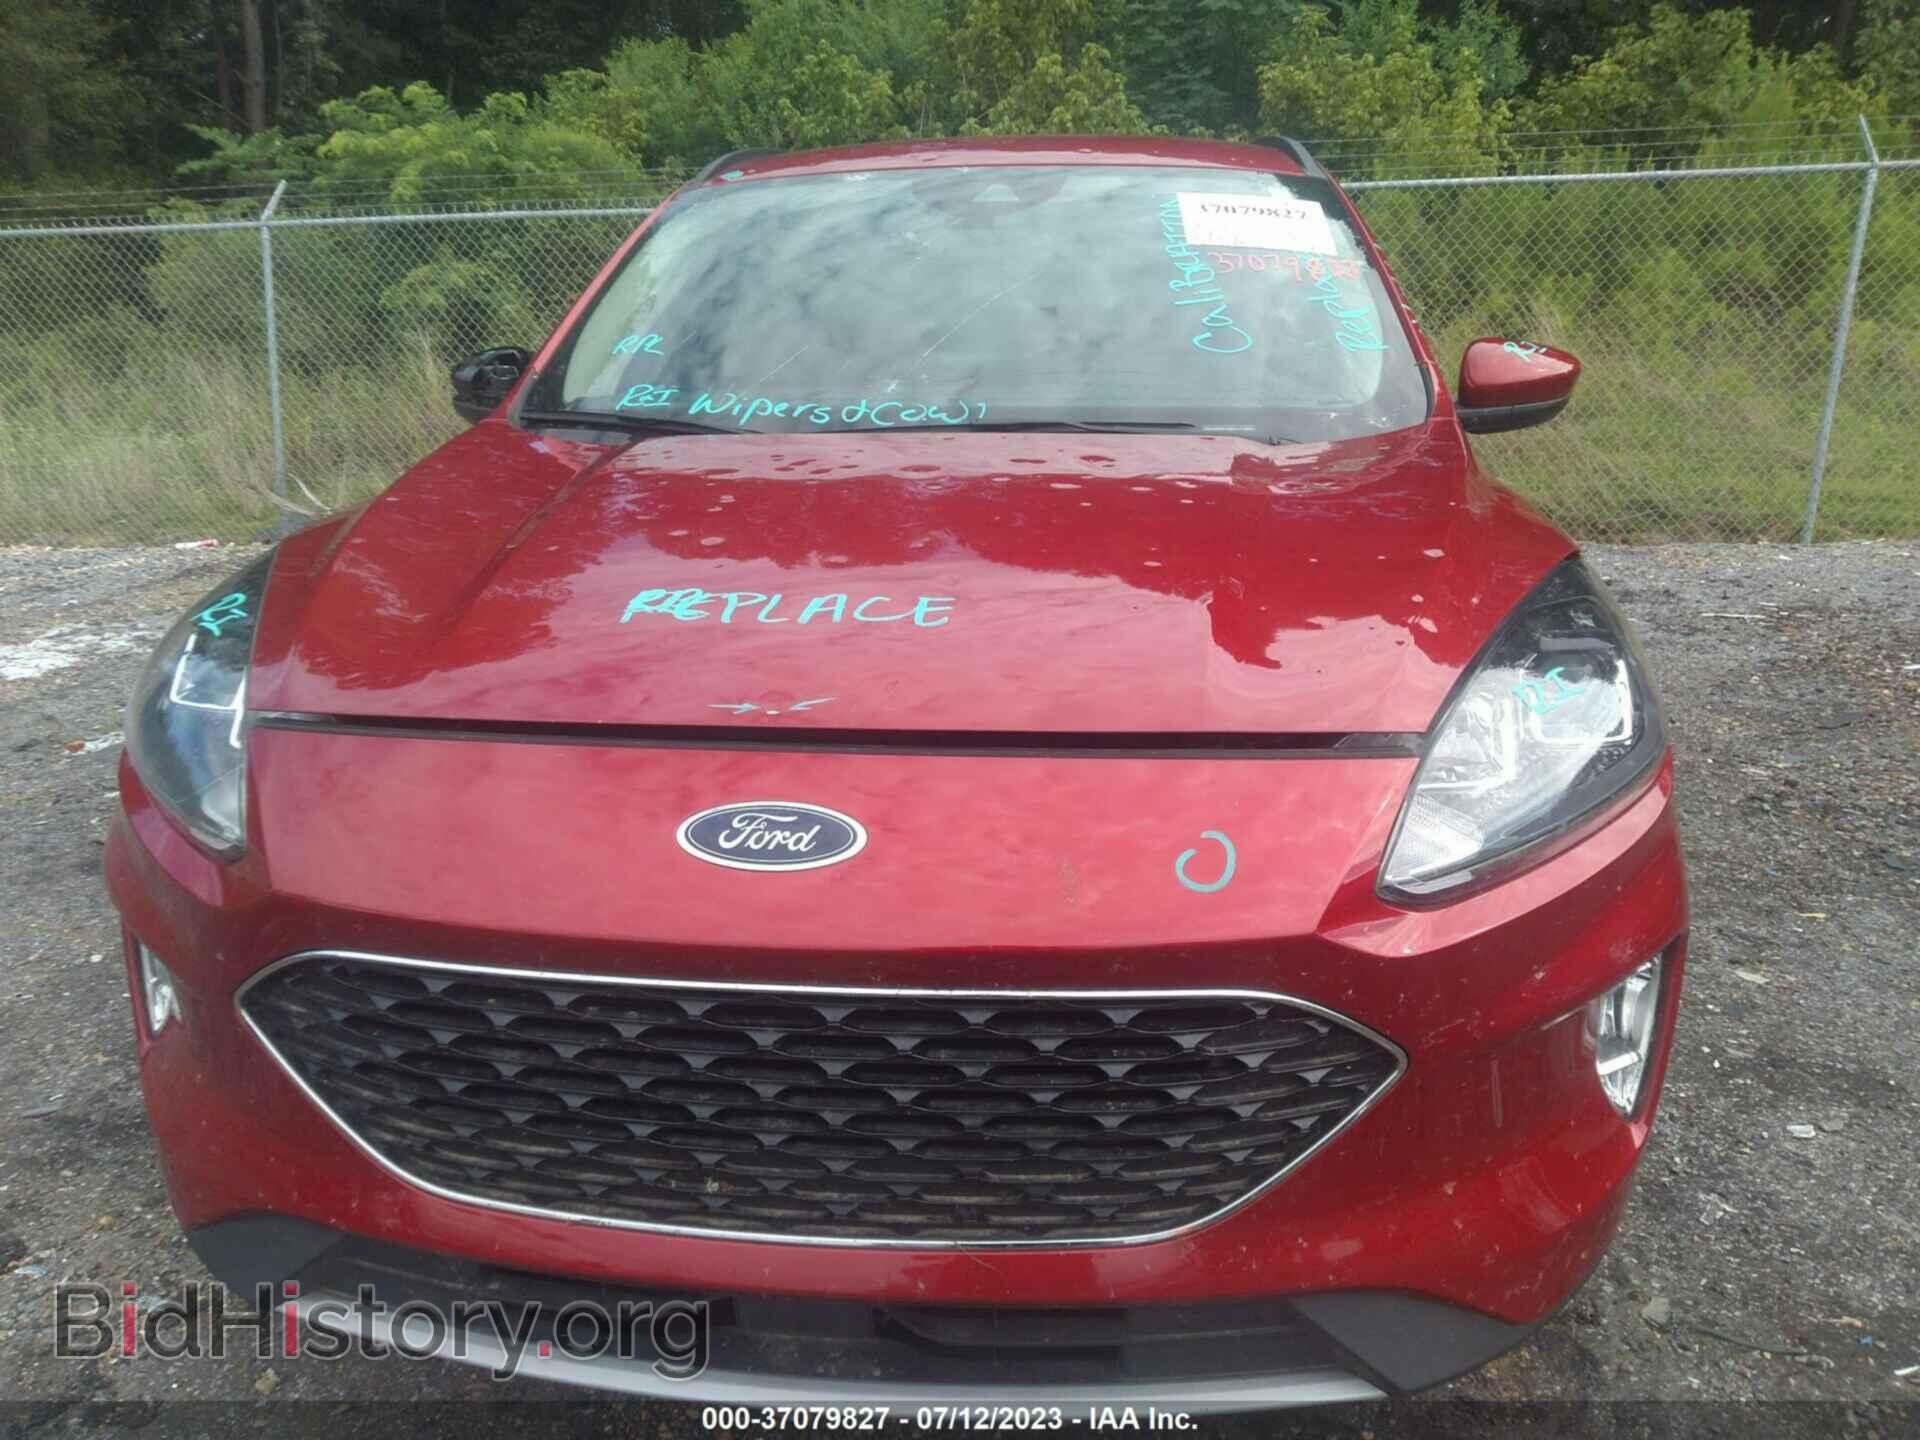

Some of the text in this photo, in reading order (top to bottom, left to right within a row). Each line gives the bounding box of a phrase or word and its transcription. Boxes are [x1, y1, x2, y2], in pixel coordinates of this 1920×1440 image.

[688, 392, 832, 427] Wipers
[618, 587, 957, 627] REPLACE
[718, 812, 822, 852] Ford
